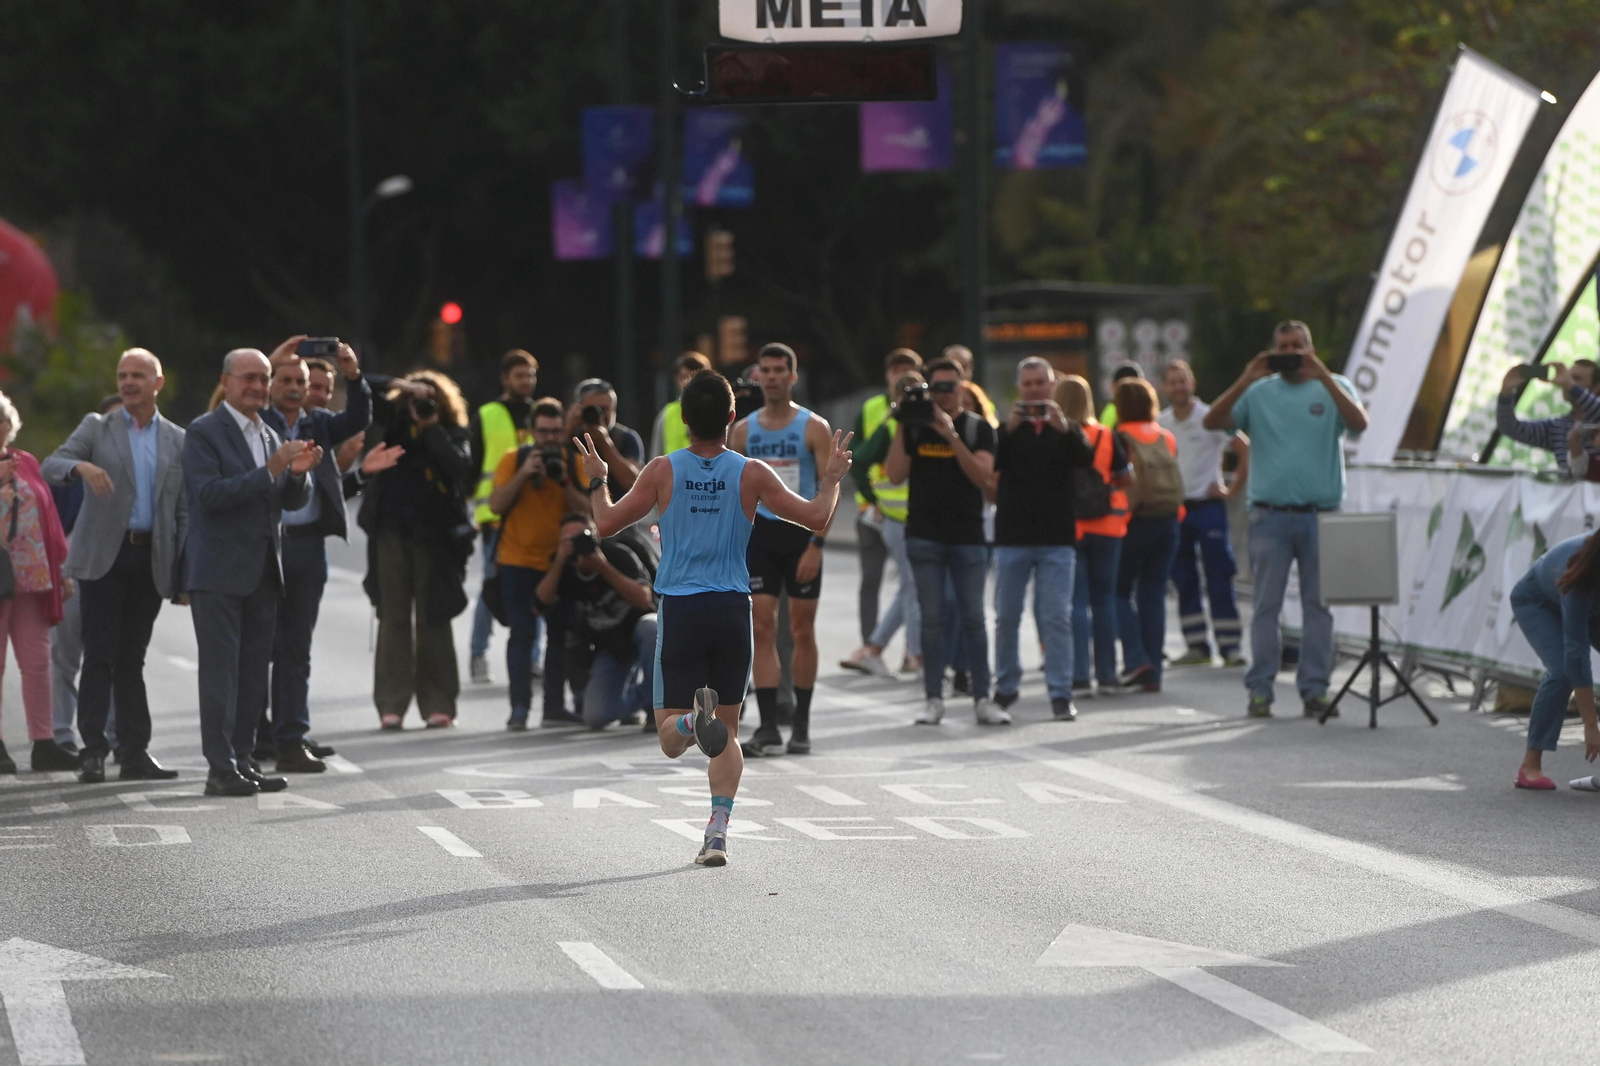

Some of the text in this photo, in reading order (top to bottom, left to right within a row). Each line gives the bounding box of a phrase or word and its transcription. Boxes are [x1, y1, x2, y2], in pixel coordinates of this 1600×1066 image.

[750, 440, 796, 457] nerja
[685, 478, 725, 494] nerja
[435, 782, 1127, 809] BASICA
[651, 816, 1034, 842] RED
